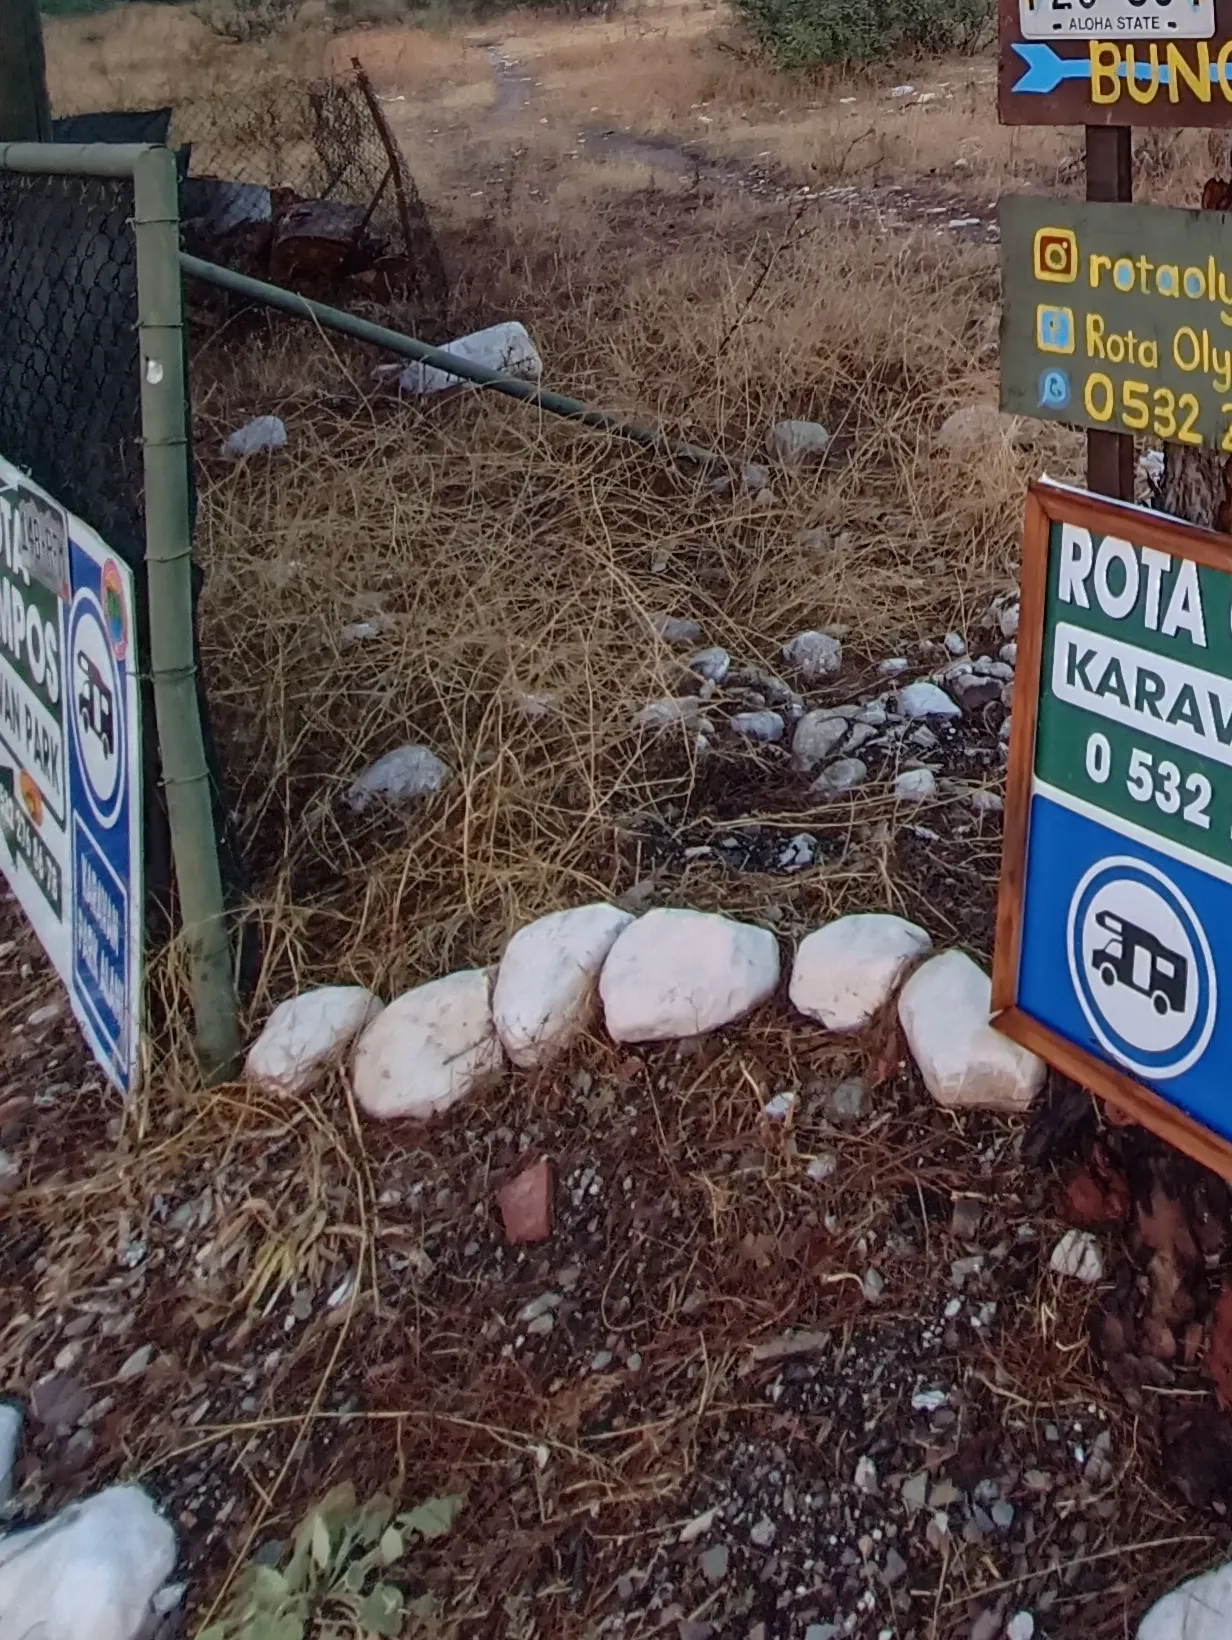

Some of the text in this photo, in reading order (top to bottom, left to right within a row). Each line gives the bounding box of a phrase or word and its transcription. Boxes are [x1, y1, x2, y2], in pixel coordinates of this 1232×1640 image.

[1069, 16, 1160, 31] ALOHA STATE
[1085, 312, 1158, 369] Rota
[1058, 522, 1208, 649] ROTA
[24, 703, 60, 796] PARK
[1085, 732, 1111, 784] 0
[1126, 748, 1212, 829] 532
